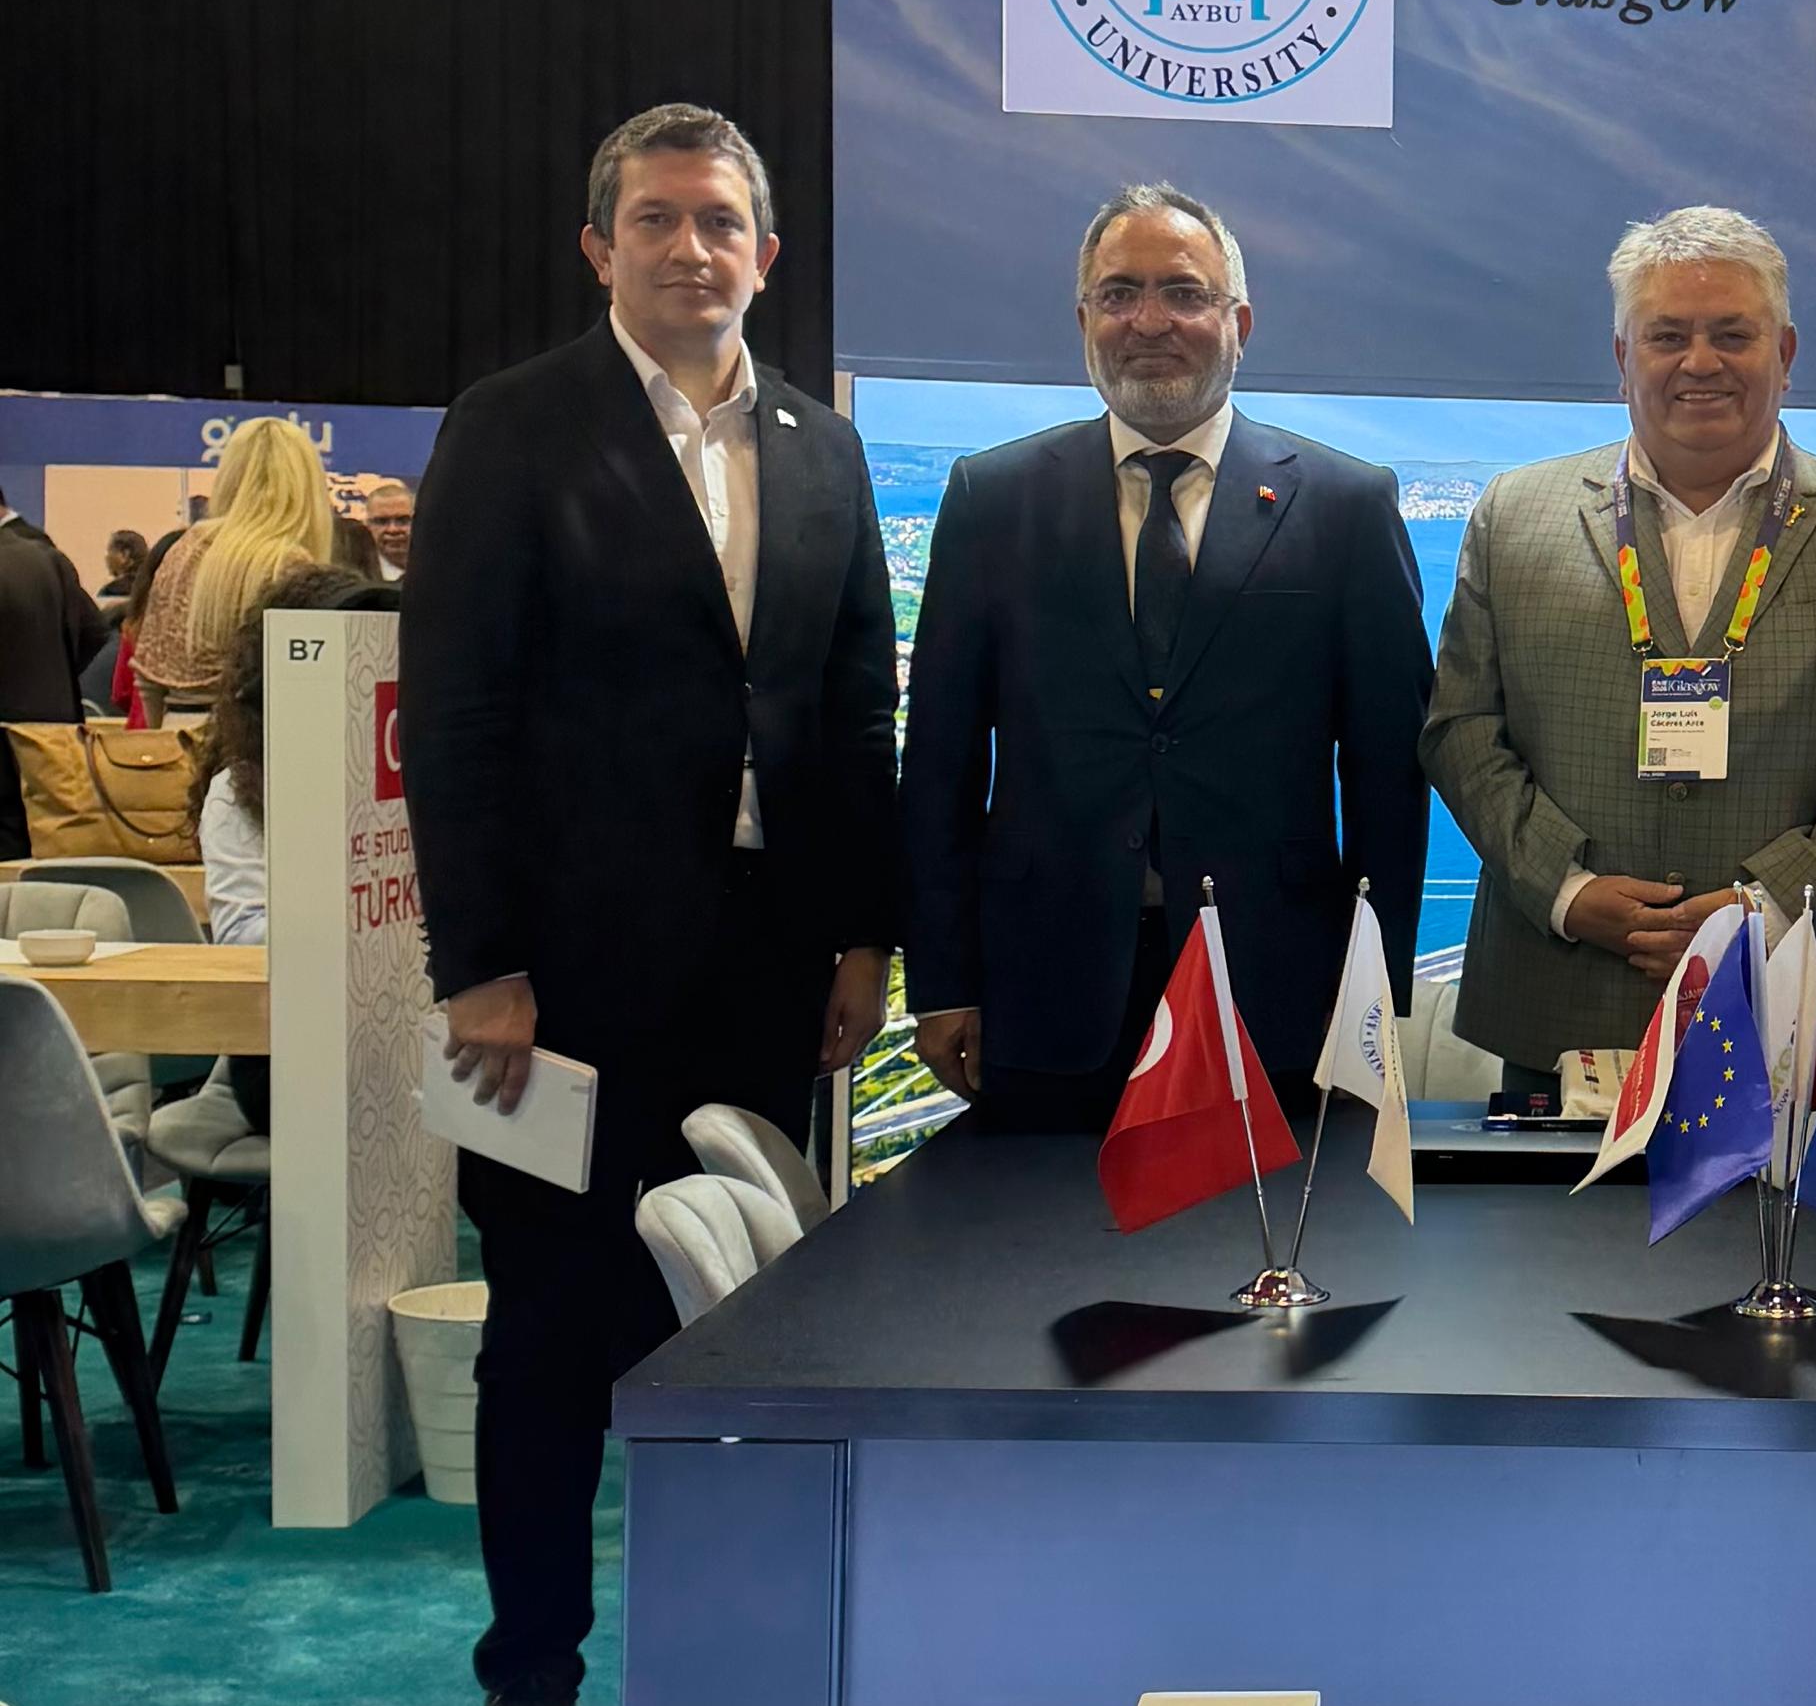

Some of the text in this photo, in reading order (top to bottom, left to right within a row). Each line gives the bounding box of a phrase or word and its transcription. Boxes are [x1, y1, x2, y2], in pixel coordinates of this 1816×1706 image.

[1170, 3, 1243, 24] AYBU
[1086, 14, 1328, 98] UNIVERSITY
[289, 639, 325, 661] B7
[374, 827, 410, 858] STUD
[351, 869, 423, 933] TÜRK
